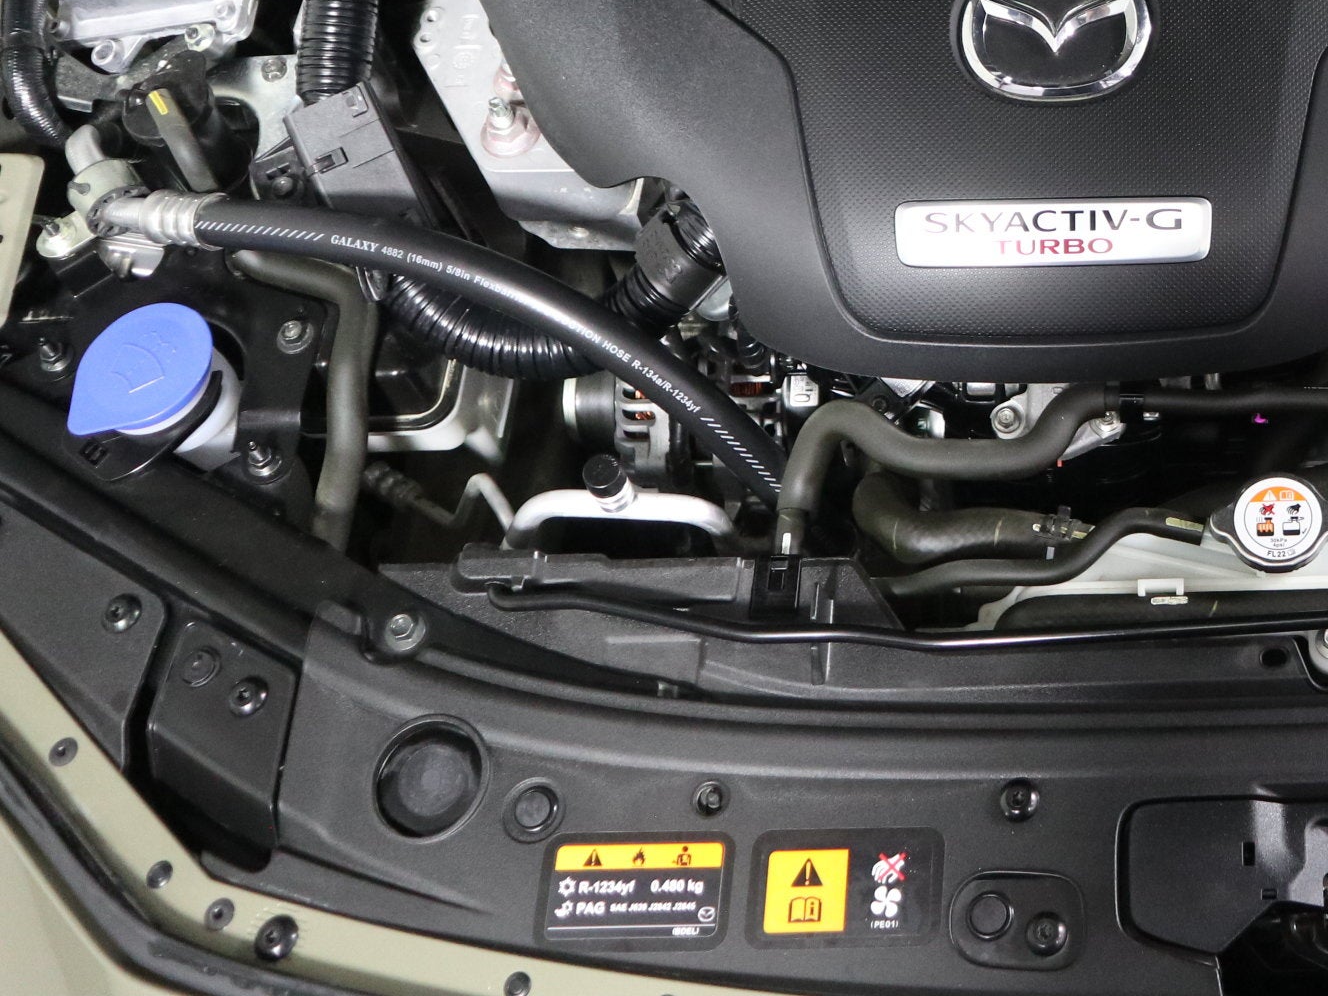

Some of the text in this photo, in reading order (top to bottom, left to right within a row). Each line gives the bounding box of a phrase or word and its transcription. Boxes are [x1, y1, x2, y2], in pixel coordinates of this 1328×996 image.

[924, 208, 1183, 234] SKYACTIV-G
[994, 237, 1114, 255] TURBO
[330, 234, 380, 252] GALAXY
[381, 245, 404, 259] 4882
[406, 252, 443, 272] (16mm)
[446, 265, 471, 281] 5/8in
[602, 339, 631, 363] HOSE
[631, 359, 701, 414] R-134a/R-1234yf
[578, 879, 636, 896] R-1234yf
[687, 878, 704, 896] kg
[575, 901, 606, 916] PAG
[870, 920, 899, 929] (PE01)
